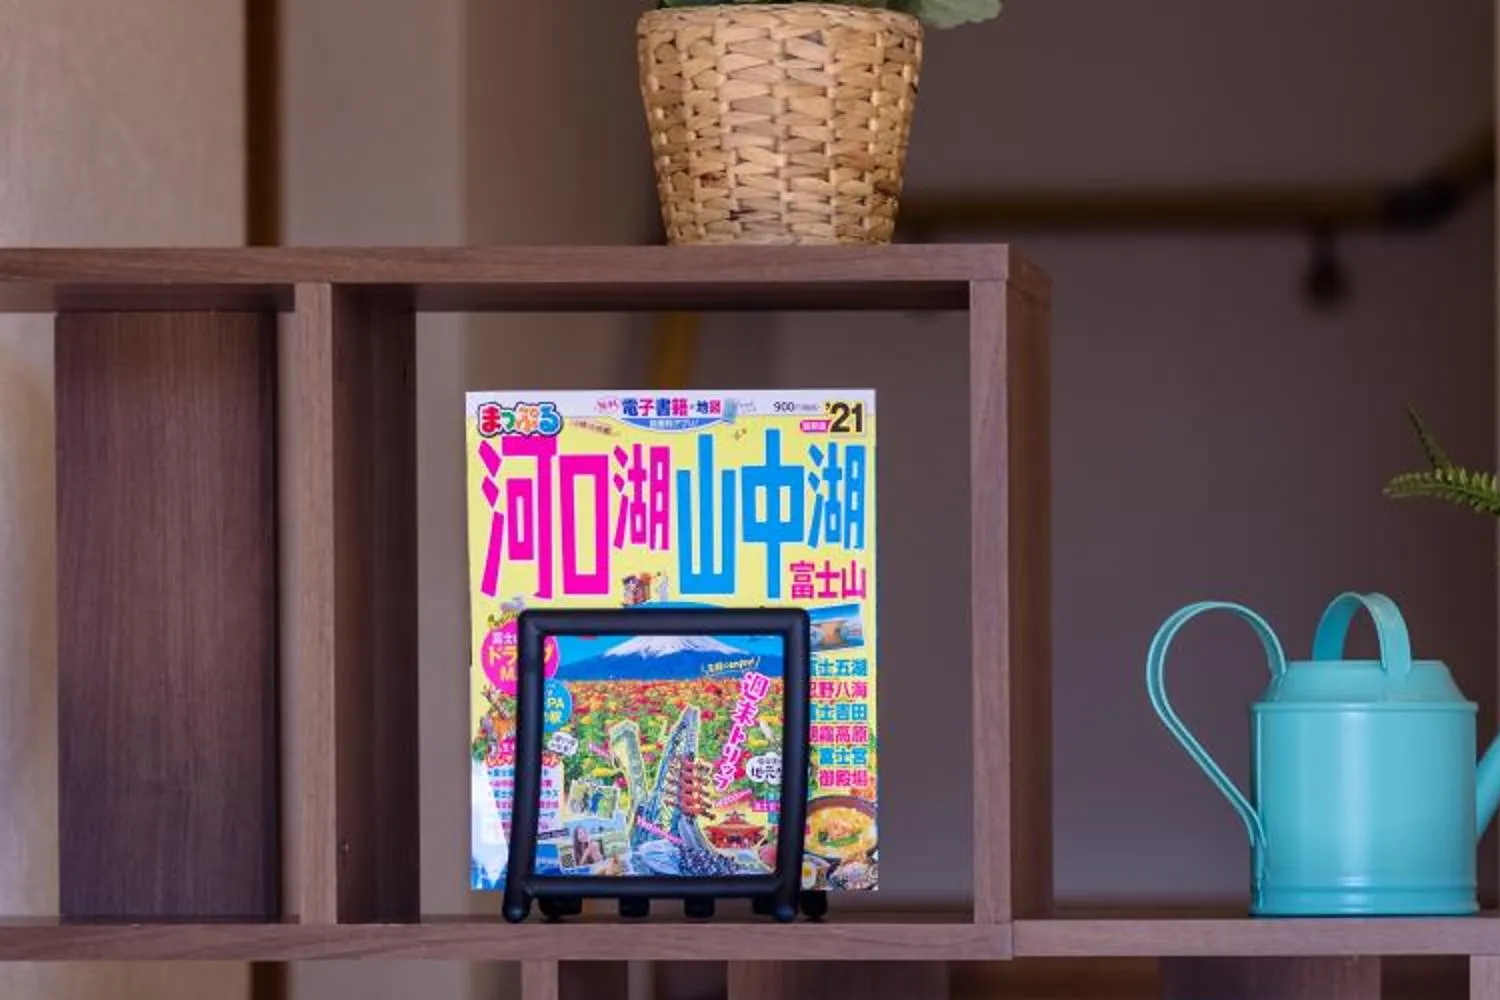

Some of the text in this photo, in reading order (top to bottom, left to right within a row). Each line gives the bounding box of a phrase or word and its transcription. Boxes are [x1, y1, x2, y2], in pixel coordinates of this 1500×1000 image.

[481, 404, 561, 434] まっぷる
[790, 560, 867, 600] 富士山
